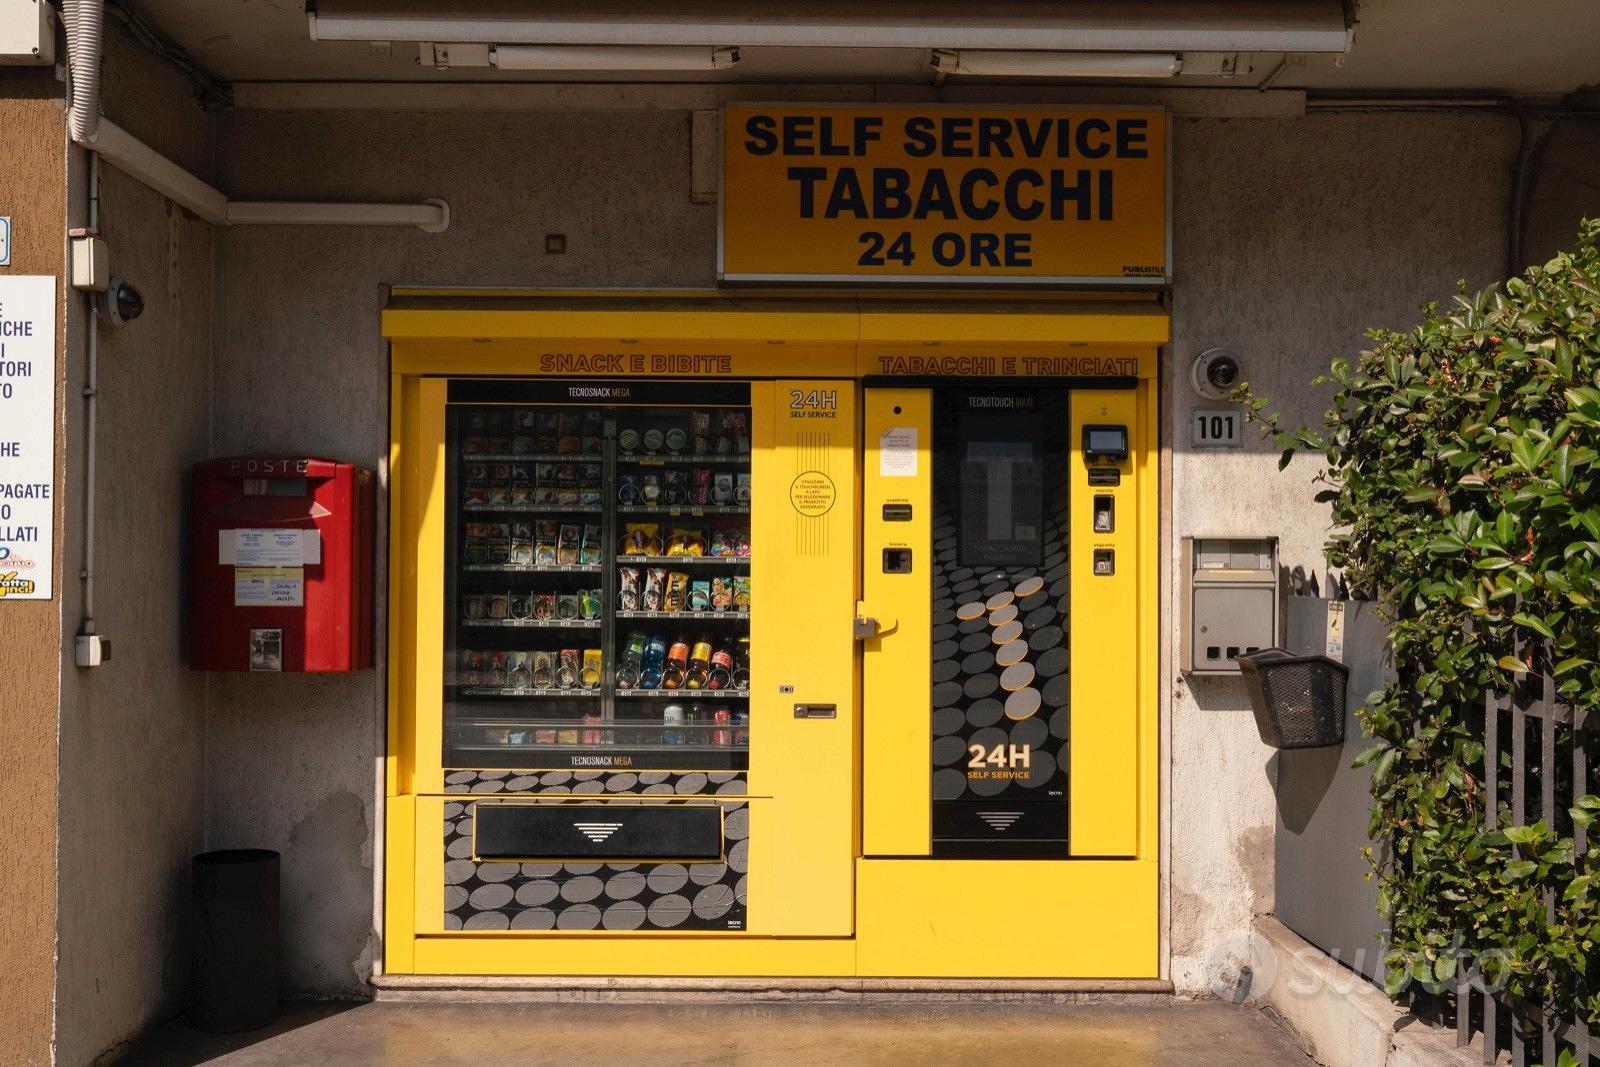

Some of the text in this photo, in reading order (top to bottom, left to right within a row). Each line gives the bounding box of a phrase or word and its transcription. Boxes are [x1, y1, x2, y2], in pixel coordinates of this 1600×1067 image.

[744, 115, 1149, 159] SELF SERVICE
[786, 166, 1113, 221] TABACCHI
[857, 231, 1033, 268] 24 ORE
[539, 353, 732, 374] SNACK E BIBITE
[878, 356, 1138, 375] TABACCHI E TRINCIATI
[568, 387, 631, 398] TECNOSNACK MEGA
[790, 390, 837, 410] 24H
[968, 396, 1033, 408] TECNOTOUCH MAXI
[1198, 415, 1233, 440] 101
[231, 459, 308, 473] POSTE
[570, 756, 632, 766] TECNOSNACK MEGA
[967, 743, 1031, 768] 24H
[967, 770, 1030, 780] SELF SERVICE
